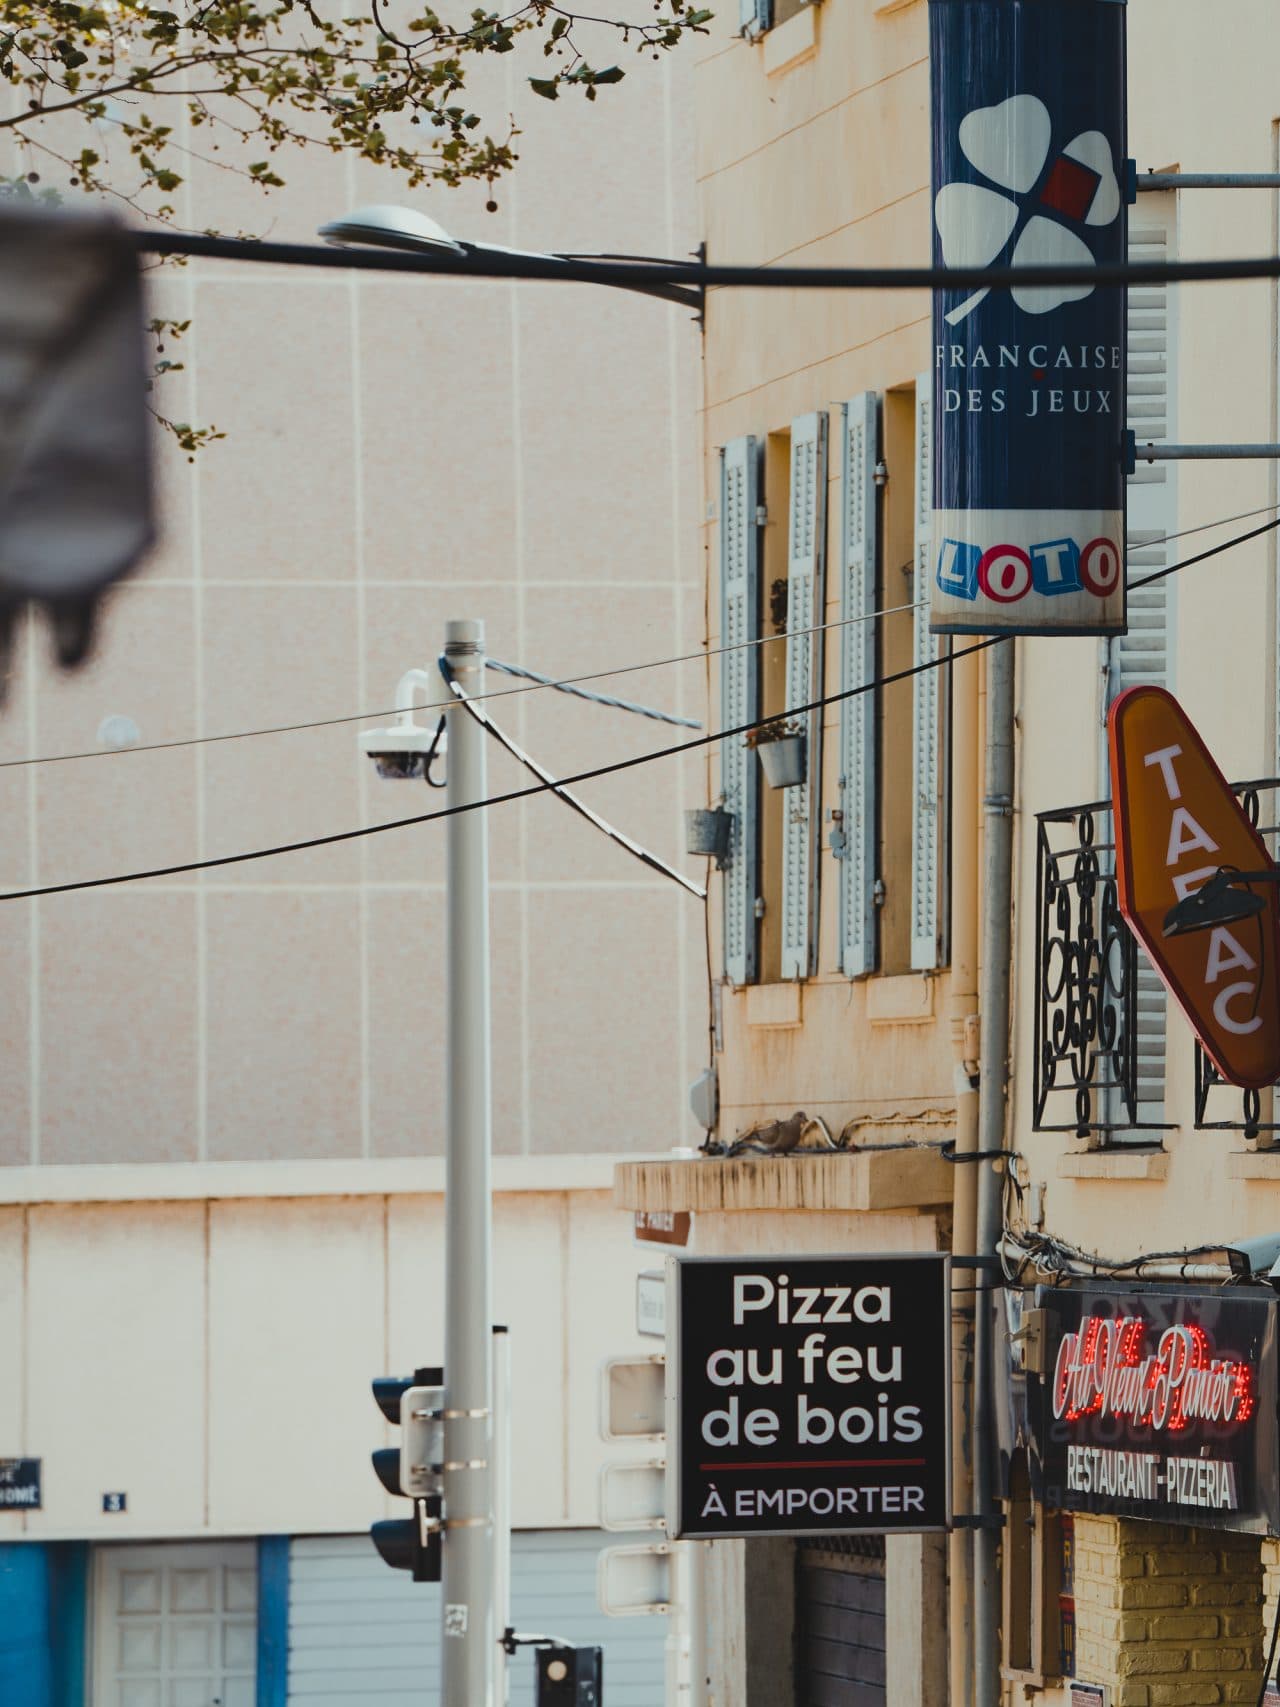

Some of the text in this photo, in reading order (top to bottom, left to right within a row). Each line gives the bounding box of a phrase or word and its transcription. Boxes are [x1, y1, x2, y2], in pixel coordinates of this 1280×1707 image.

[944, 389, 1112, 417] DES JEUX
[936, 538, 1120, 602] LOTO
[733, 1274, 891, 1325] Pizza
[706, 1333, 902, 1386] au feu
[1153, 1324, 1240, 1430] Panier
[701, 1393, 923, 1447] de bois
[701, 1483, 925, 1517] À EMPORTER
